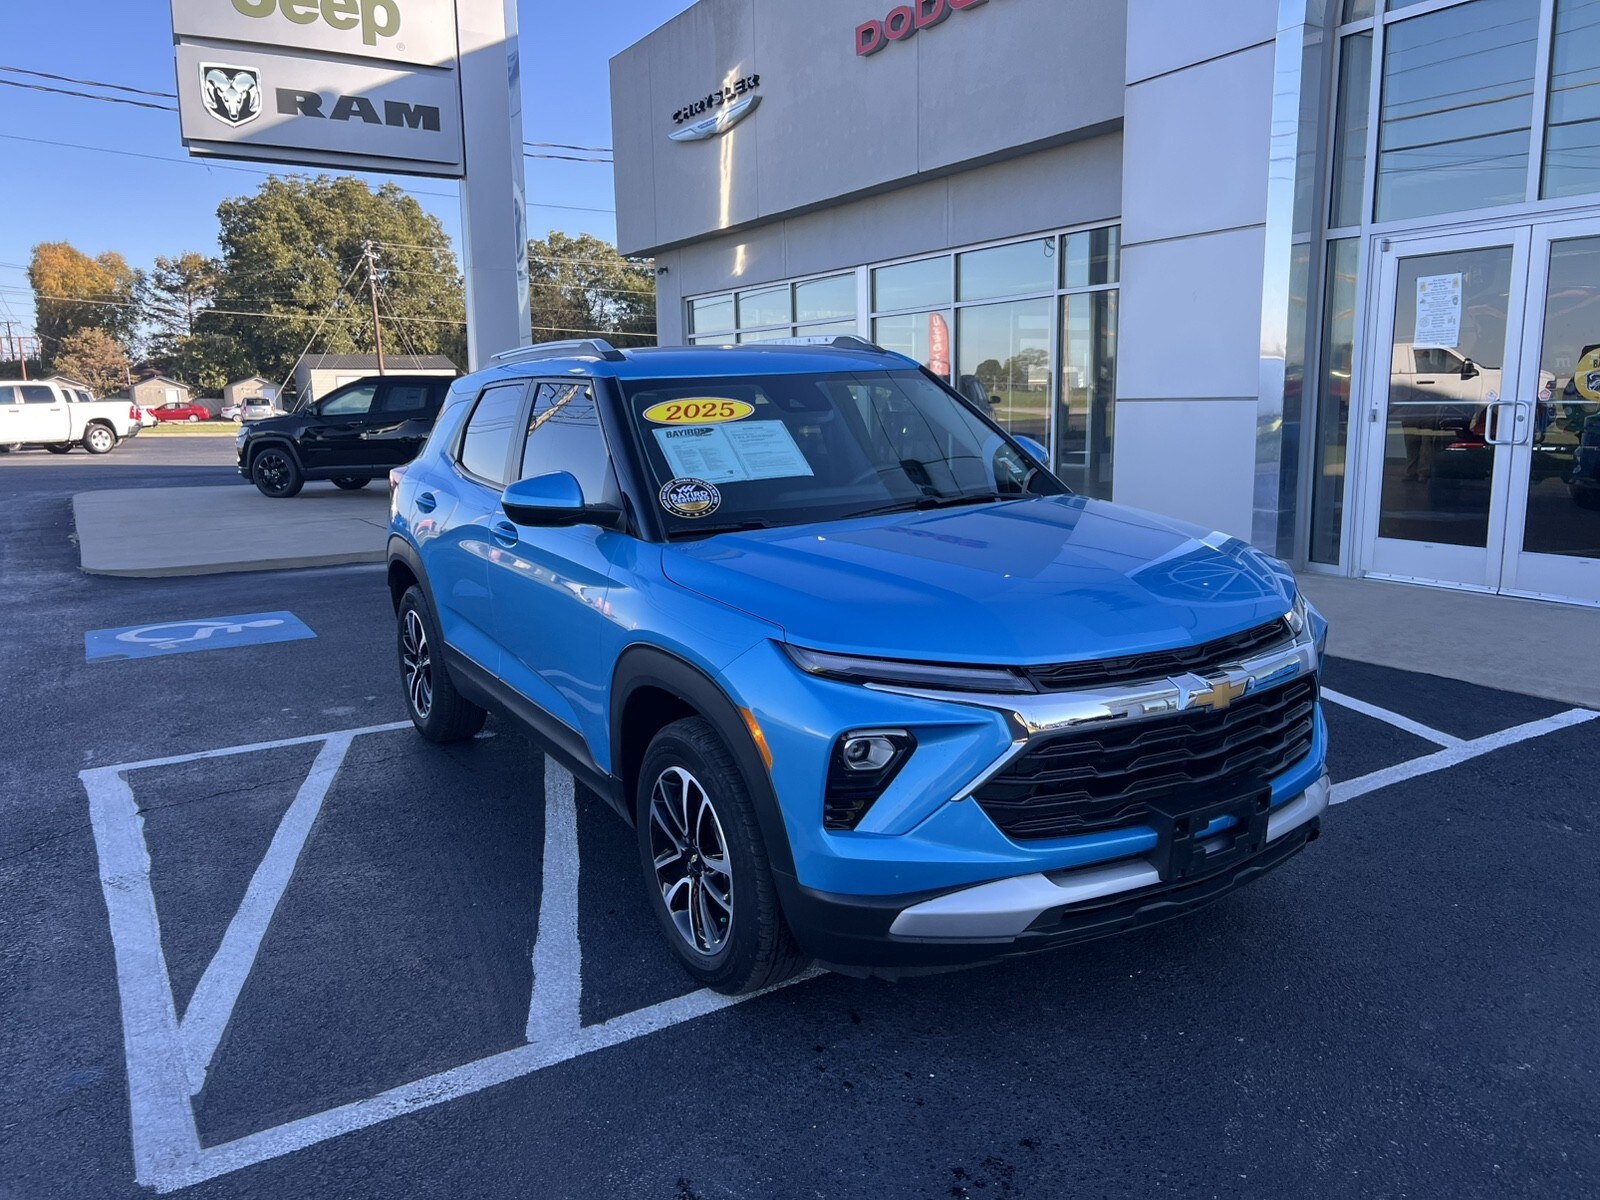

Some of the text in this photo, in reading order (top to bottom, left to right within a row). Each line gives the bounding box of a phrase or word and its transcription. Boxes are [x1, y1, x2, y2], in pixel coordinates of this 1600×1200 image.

[231, 0, 401, 46] eep
[855, 0, 984, 56] DOD
[276, 88, 441, 132] RAM
[673, 73, 760, 123] CHRYSLER
[665, 402, 735, 421] 2025
[666, 427, 701, 439] BAYIRD
[670, 490, 708, 500] BAYIRD
[672, 495, 710, 504] CERTIFIED
